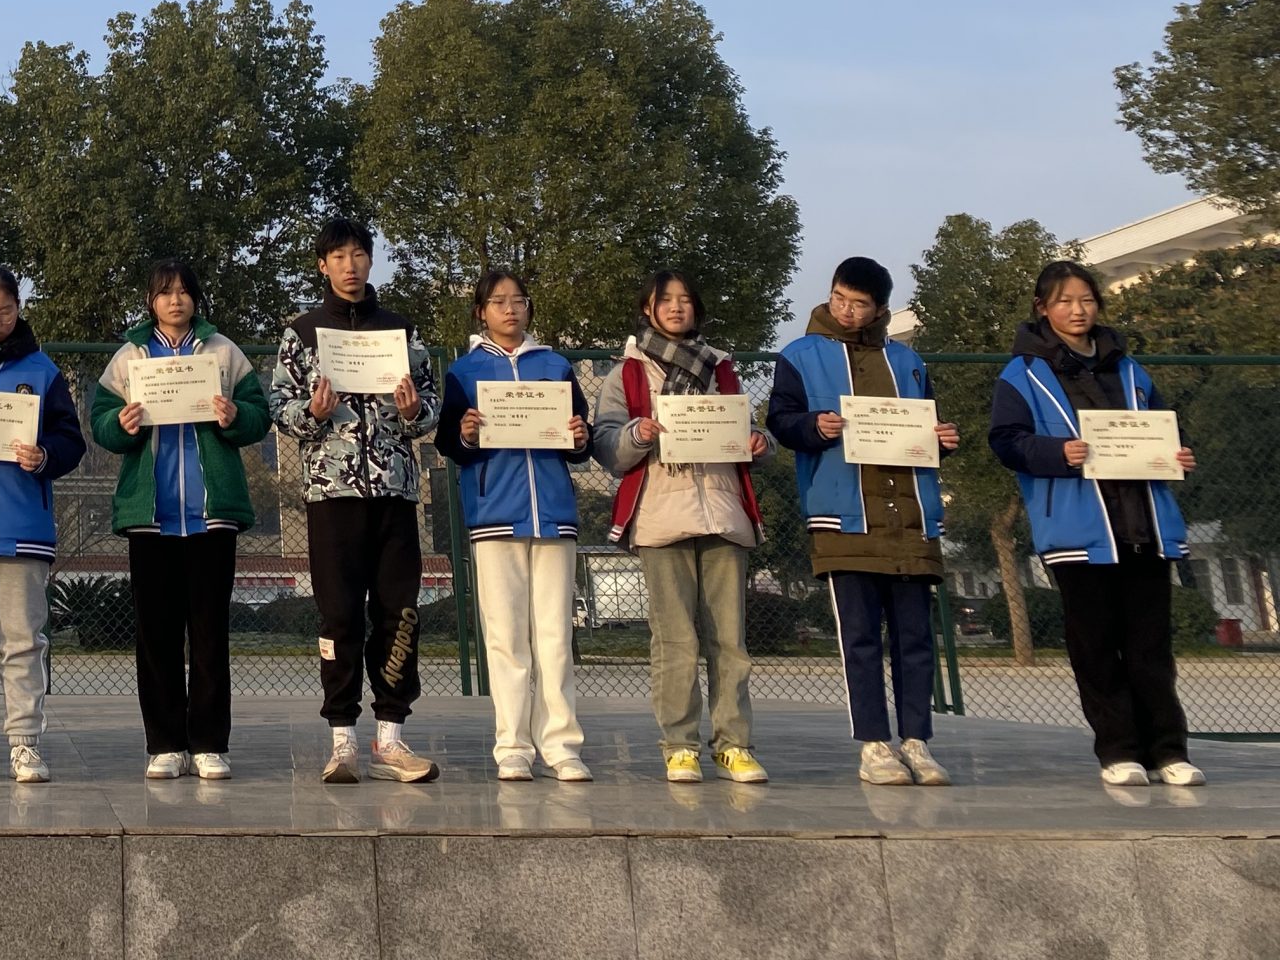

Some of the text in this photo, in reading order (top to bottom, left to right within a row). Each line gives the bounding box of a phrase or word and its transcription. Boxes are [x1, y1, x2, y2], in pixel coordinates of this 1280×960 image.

[505, 391, 545, 399] 荣誉证书
[686, 405, 726, 413] 荣誉证书
[380, 607, 419, 688] Osolenly
